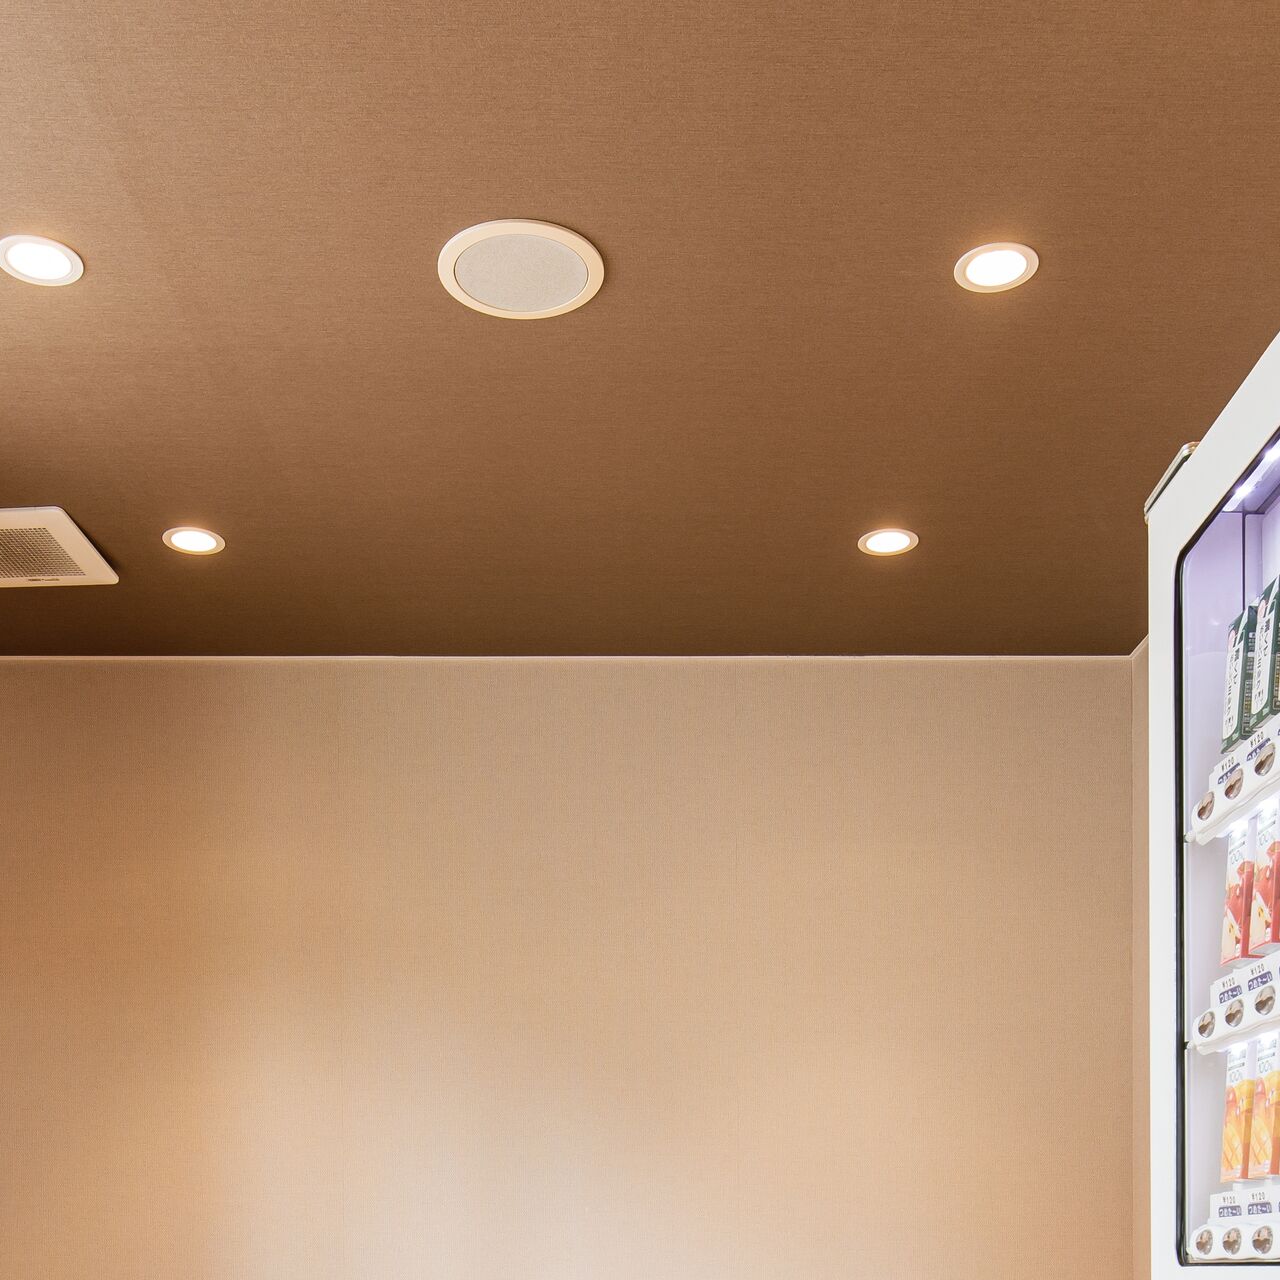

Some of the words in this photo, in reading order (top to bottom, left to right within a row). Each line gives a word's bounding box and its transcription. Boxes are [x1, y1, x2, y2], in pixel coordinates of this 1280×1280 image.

[1250, 963, 1265, 976] ¥120
[1222, 977, 1236, 989] ¥120
[1222, 1196, 1236, 1204] ¥120
[1251, 1192, 1265, 1201] ¥120
